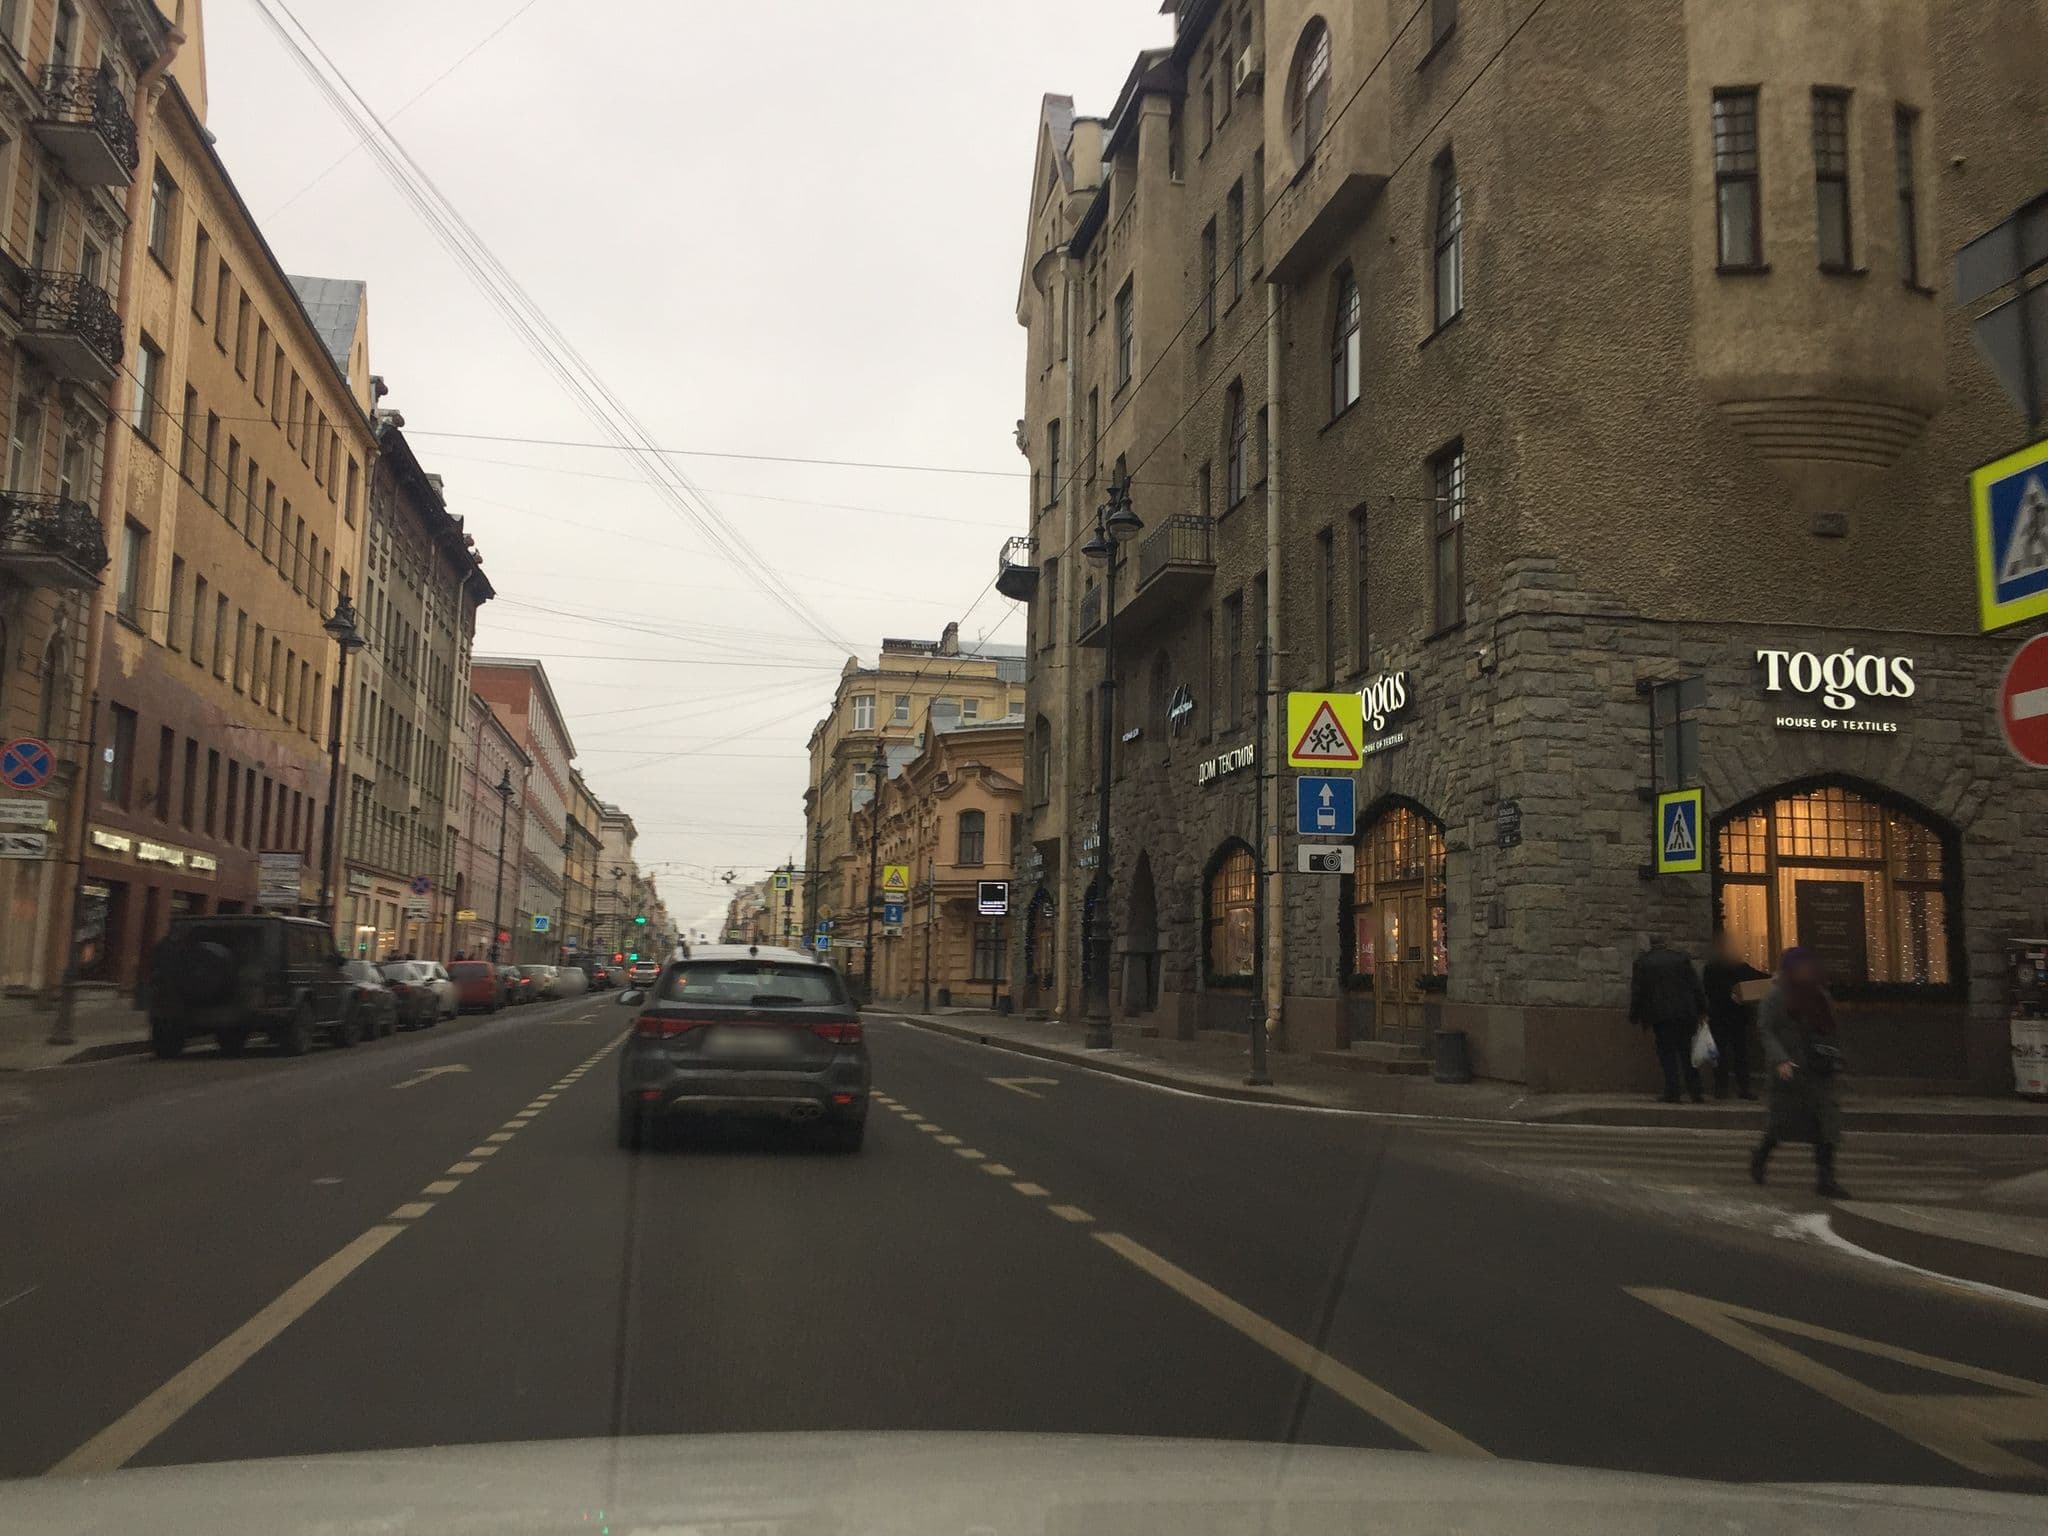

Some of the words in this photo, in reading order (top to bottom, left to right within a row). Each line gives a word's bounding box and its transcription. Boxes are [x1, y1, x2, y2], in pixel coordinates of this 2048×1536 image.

[1356, 671, 1406, 731] ogas
[1756, 647, 1916, 711] Togas
[1776, 716, 1817, 729] HOUSE
[1821, 719, 1838, 730] OF
[1842, 720, 1898, 733] TEXTILES
[1198, 758, 1216, 787] ДОМ
[1218, 743, 1254, 775] ТЕКСТИЛЯ
